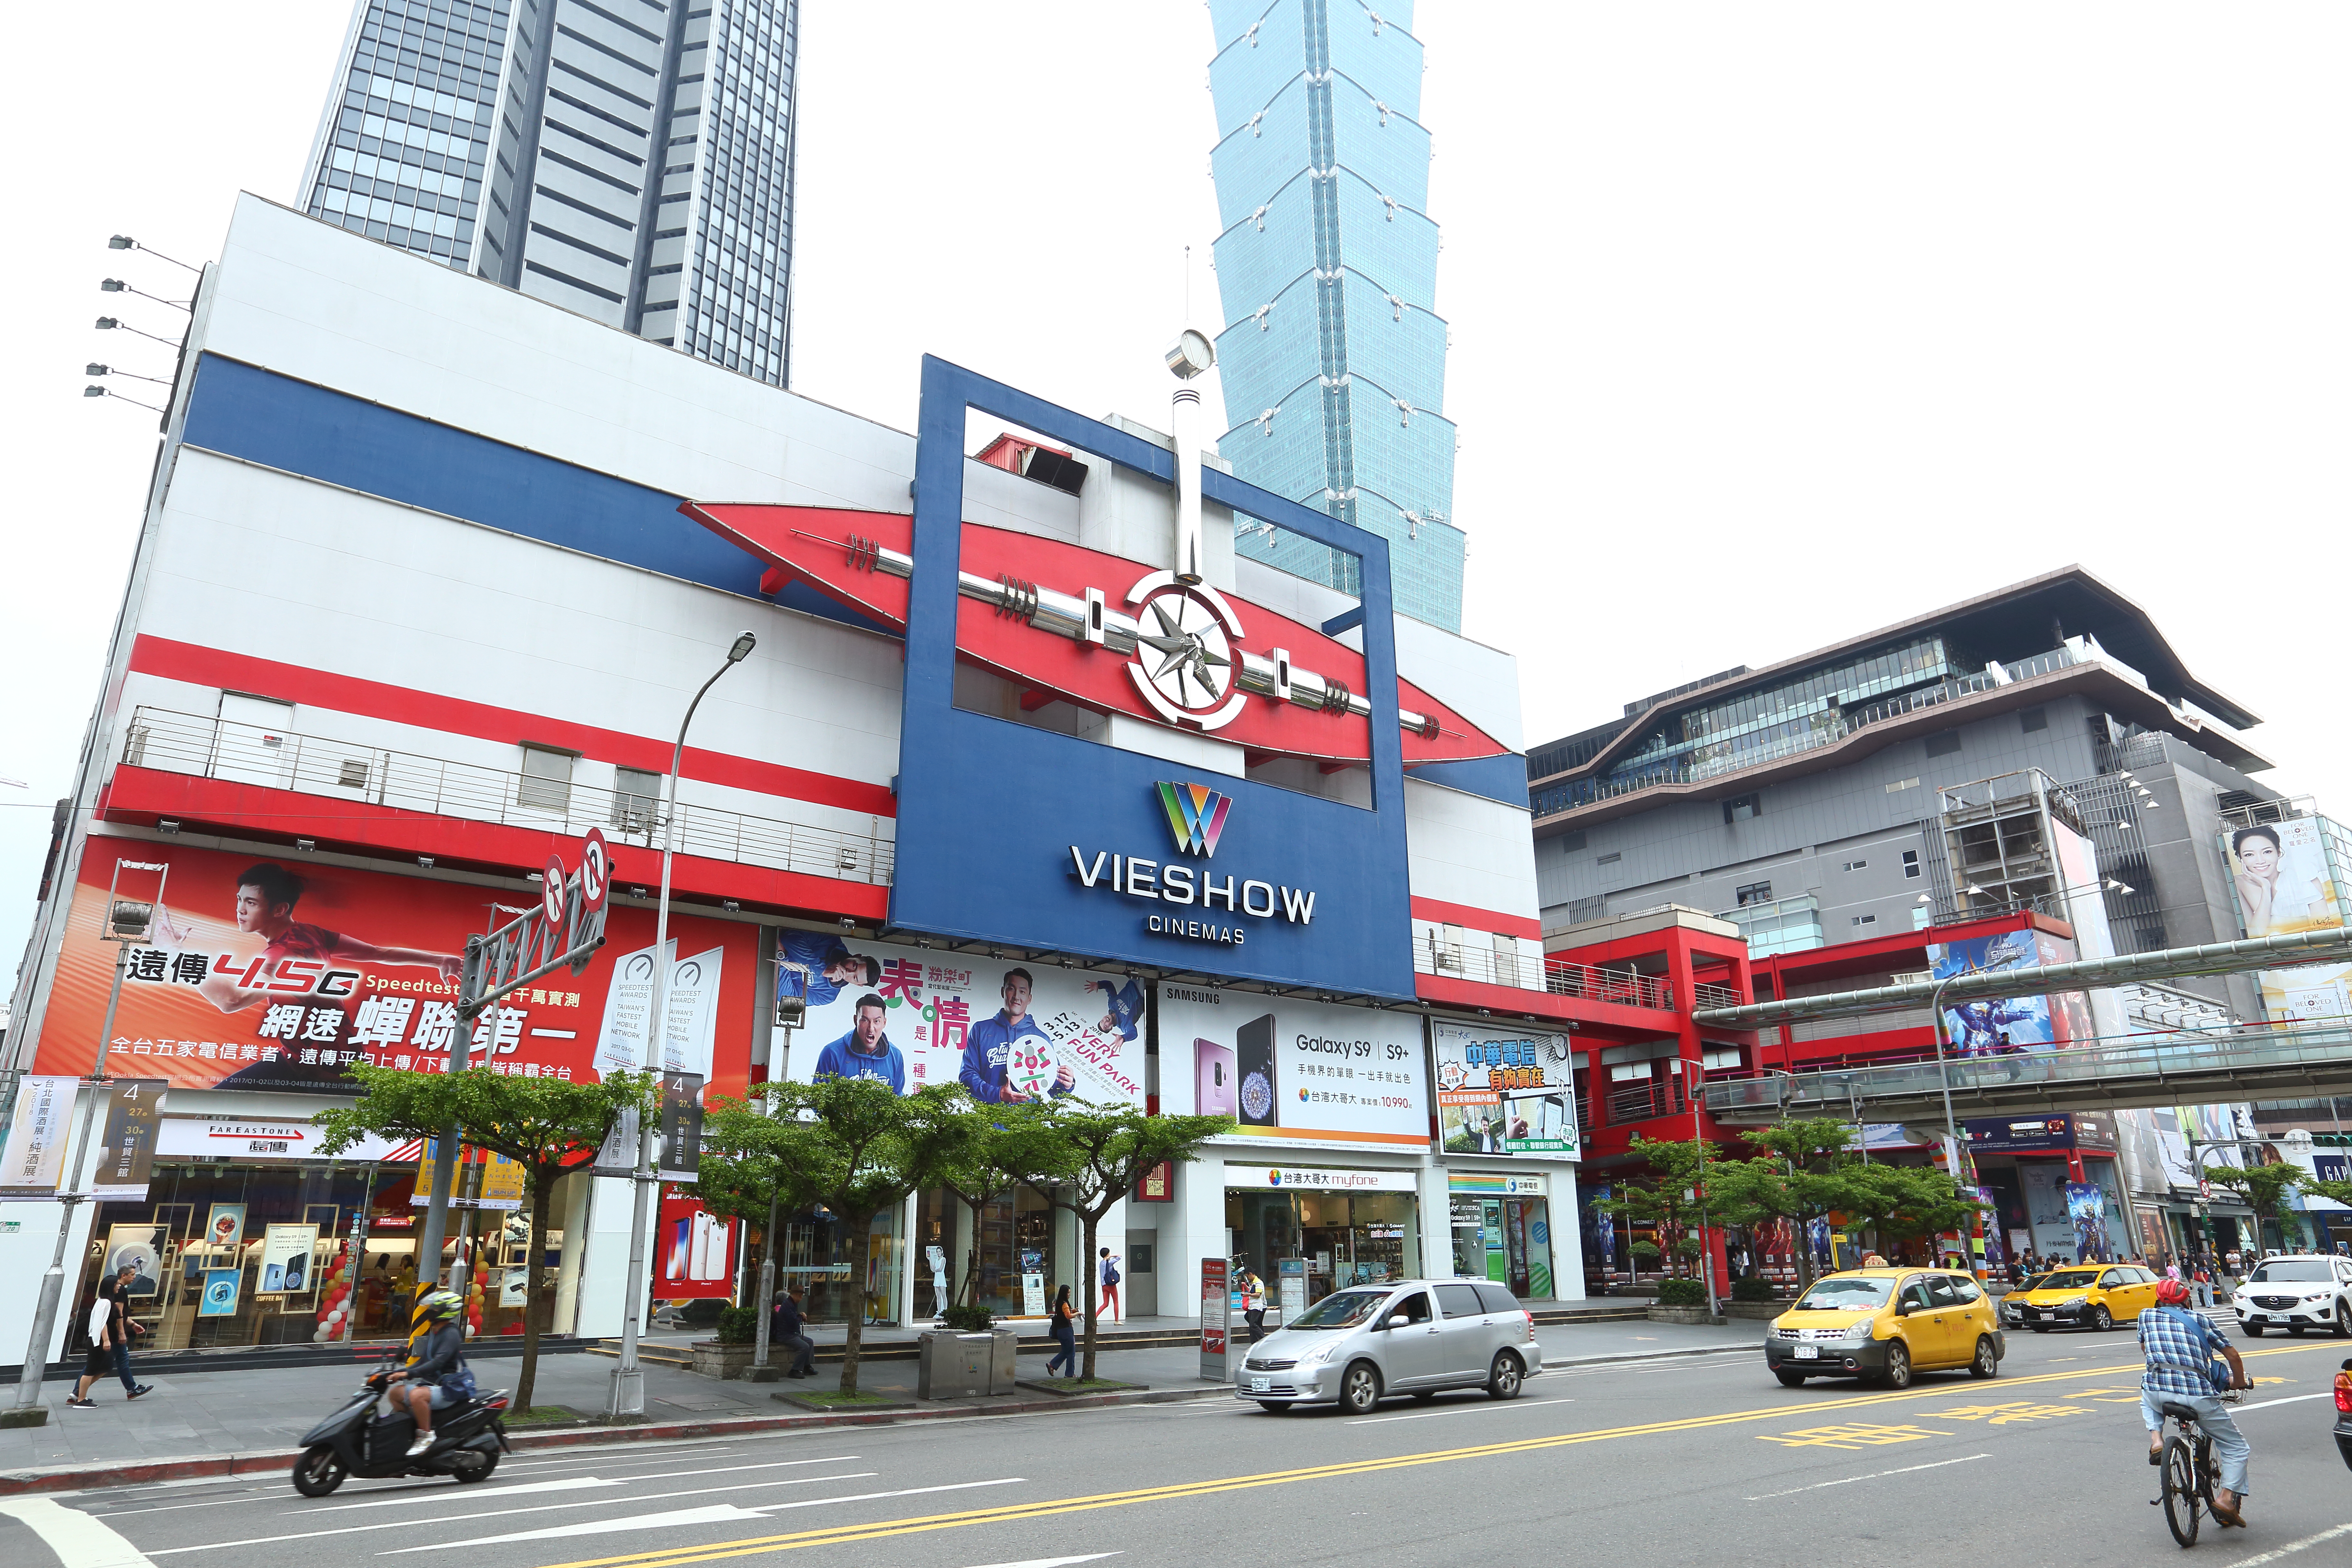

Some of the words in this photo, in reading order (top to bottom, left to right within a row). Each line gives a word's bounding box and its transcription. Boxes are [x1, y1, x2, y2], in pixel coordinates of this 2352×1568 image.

[2283, 825, 2314, 835] BELOVED
[1068, 845, 1316, 925] VIESHOW
[1148, 915, 1244, 944] CINEMAS
[126, 947, 209, 985] 遠傳
[366, 975, 460, 996] Speedtest
[1167, 987, 1220, 1005] SAMSUNG
[2295, 999, 2331, 1007] BELOVED
[617, 1004, 645, 1012] TAIWAN'S
[617, 1012, 642, 1020] FASTEST
[1043, 1012, 1069, 1031] 3.17
[258, 995, 577, 1056] 網速蟬聯第一
[616, 1020, 638, 1029] MOBILE
[1089, 1025, 1103, 1036] 2018
[611, 1028, 641, 1039] NETWORK
[667, 1033, 690, 1043] ETWORK
[1082, 1029, 1121, 1059] VERY
[1296, 1033, 1352, 1060] Galaxy
[1354, 1040, 1371, 1057] S9
[1386, 1044, 1410, 1060] S9+
[1465, 1039, 1537, 1069] 中華電信
[1067, 1038, 1102, 1064] FUN
[1098, 1062, 1142, 1095] PARK
[1297, 1063, 1355, 1080] 手機界的單眼
[1357, 1070, 1411, 1085] 一出手就出色
[1444, 1066, 1459, 1078] 行動
[672, 1077, 684, 1093] 4
[1488, 1067, 1545, 1091] 有夠實在
[123, 1084, 138, 1100] 4
[1311, 1091, 1357, 1106] 台湾大哥大
[1441, 1094, 1498, 1104] 真正享受得到網內優惠
[29, 1092, 38, 1115] 2018
[679, 1099, 687, 1108] 27
[129, 1108, 143, 1116] 27
[678, 1116, 687, 1125] 30
[125, 1126, 139, 1134] 30
[209, 1125, 292, 1137] FAREASTONE
[1563, 1127, 1573, 1137] 市話
[249, 1140, 288, 1154] 遠傳
[675, 1127, 685, 1165] 世貿三館
[117, 1136, 135, 1177] 世貿三館
[1283, 1172, 1329, 1185] 台湾大哥大
[1332, 1174, 1378, 1187] myfone
[2325, 1165, 2348, 1182] GAP
[1795, 1349, 1817, 1357] 418-A3
